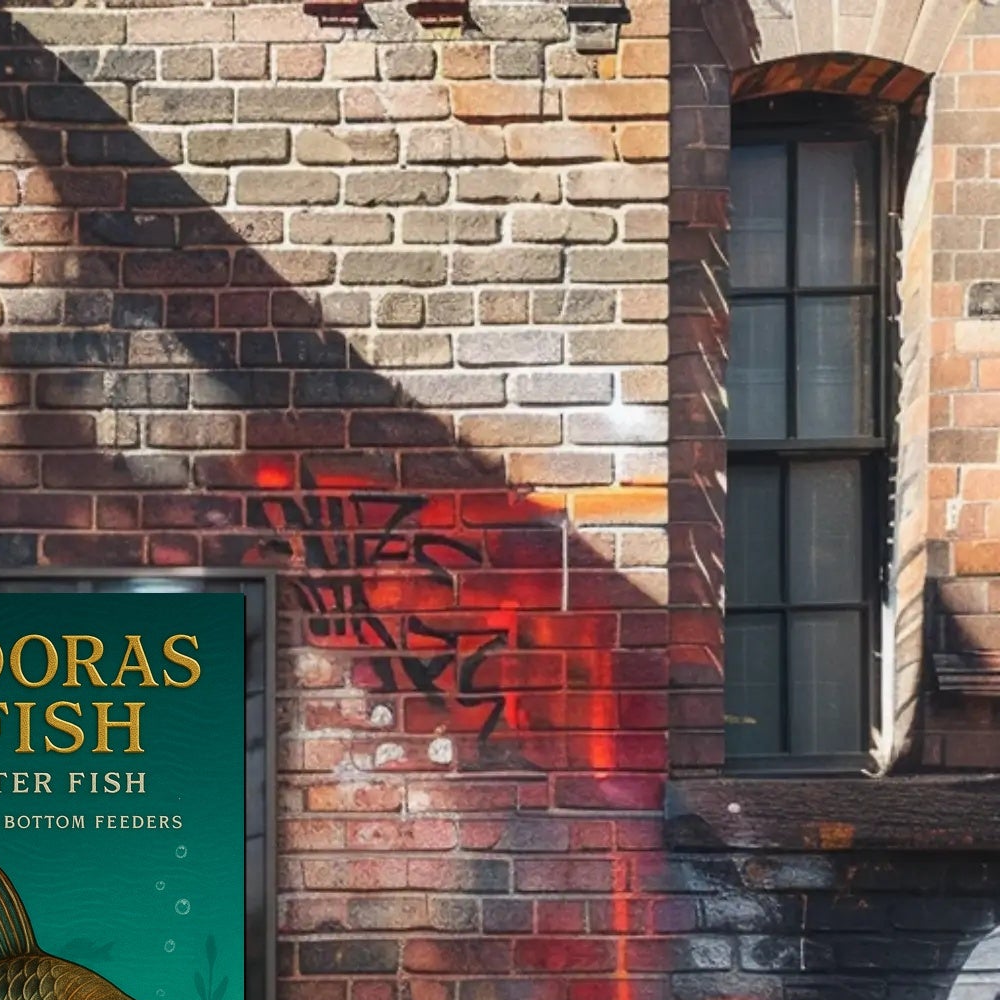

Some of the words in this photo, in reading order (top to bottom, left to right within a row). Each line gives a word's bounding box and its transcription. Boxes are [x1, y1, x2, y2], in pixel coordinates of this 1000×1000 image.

[68, 771, 147, 794] FISH
[4, 815, 85, 829] BOTTOM
[95, 815, 183, 829] FEEDERS
